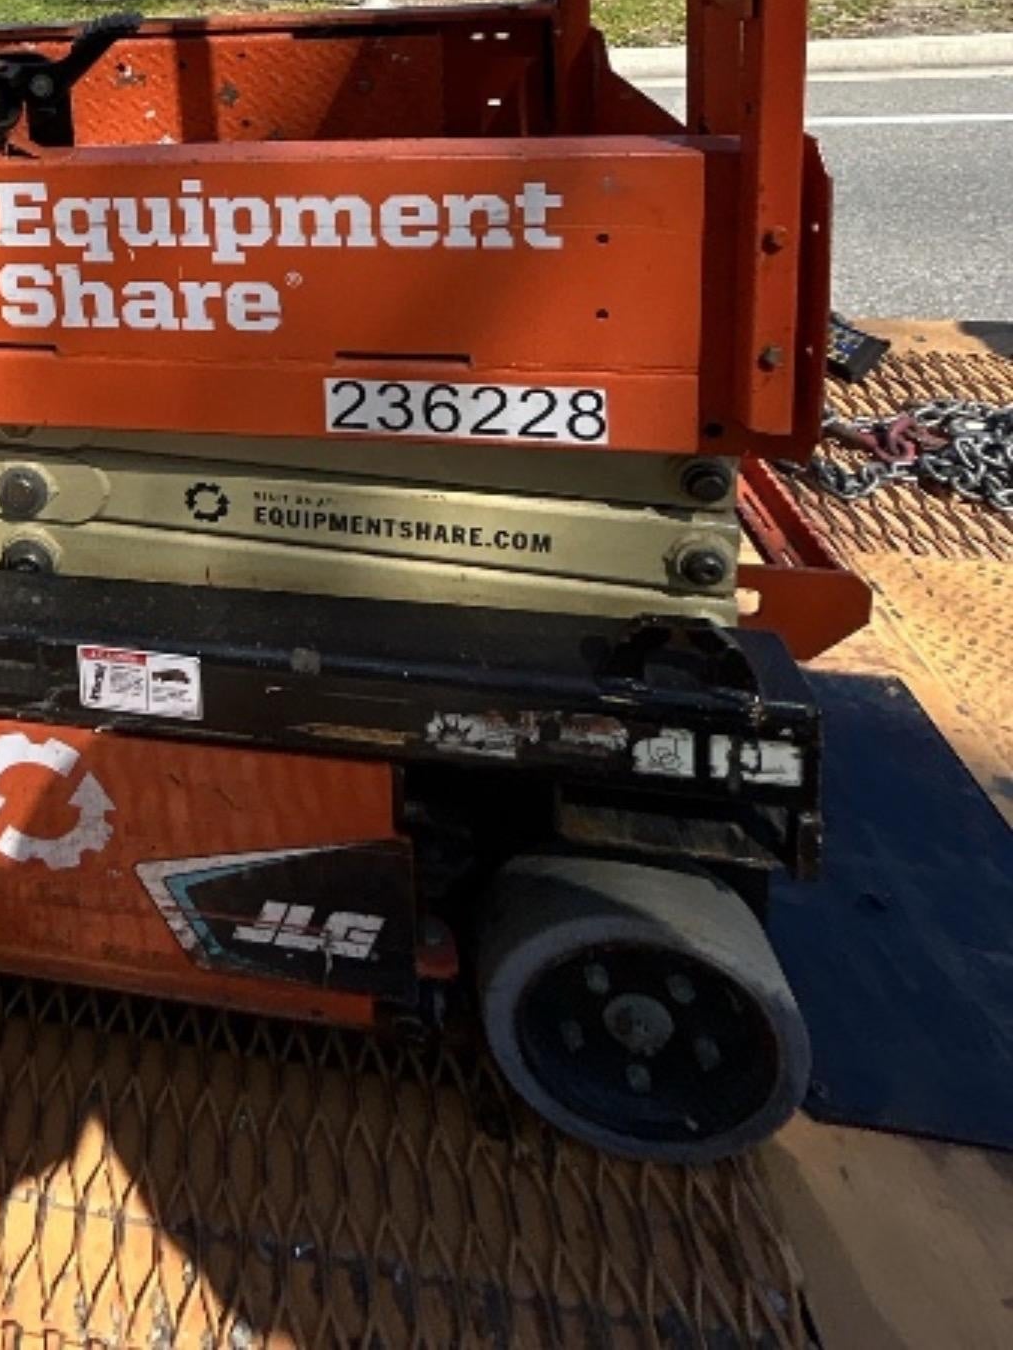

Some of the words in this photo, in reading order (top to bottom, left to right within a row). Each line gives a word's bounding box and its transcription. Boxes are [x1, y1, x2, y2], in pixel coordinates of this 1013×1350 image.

[331, 380, 606, 442] 236228
[254, 506, 553, 553] EQUIPMENTSHARE.COM
[233, 900, 386, 959] JLG
